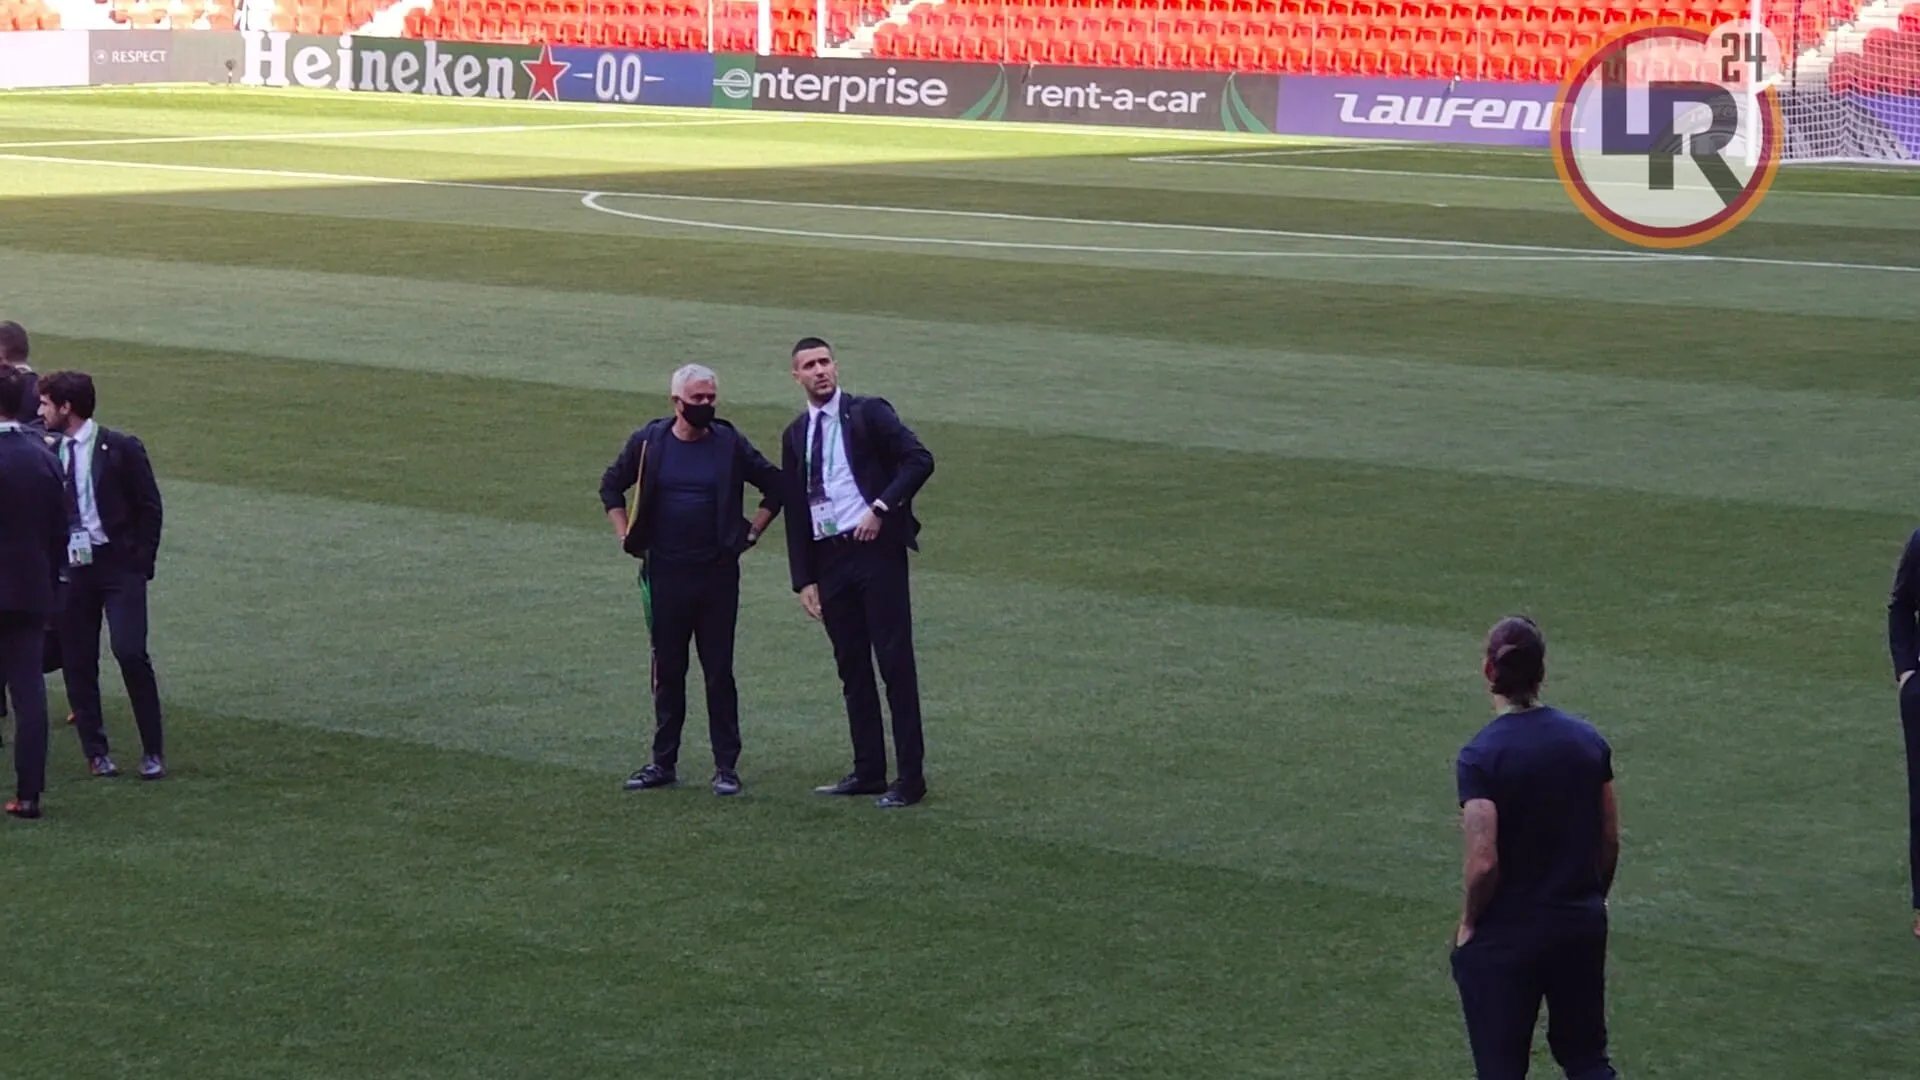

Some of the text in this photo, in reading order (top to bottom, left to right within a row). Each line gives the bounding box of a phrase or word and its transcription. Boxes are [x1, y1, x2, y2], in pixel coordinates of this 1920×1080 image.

[111, 49, 167, 64] RESPECT
[240, 30, 642, 102] Heineken 0.0
[713, 66, 1207, 115] enterprise rent-a-car
